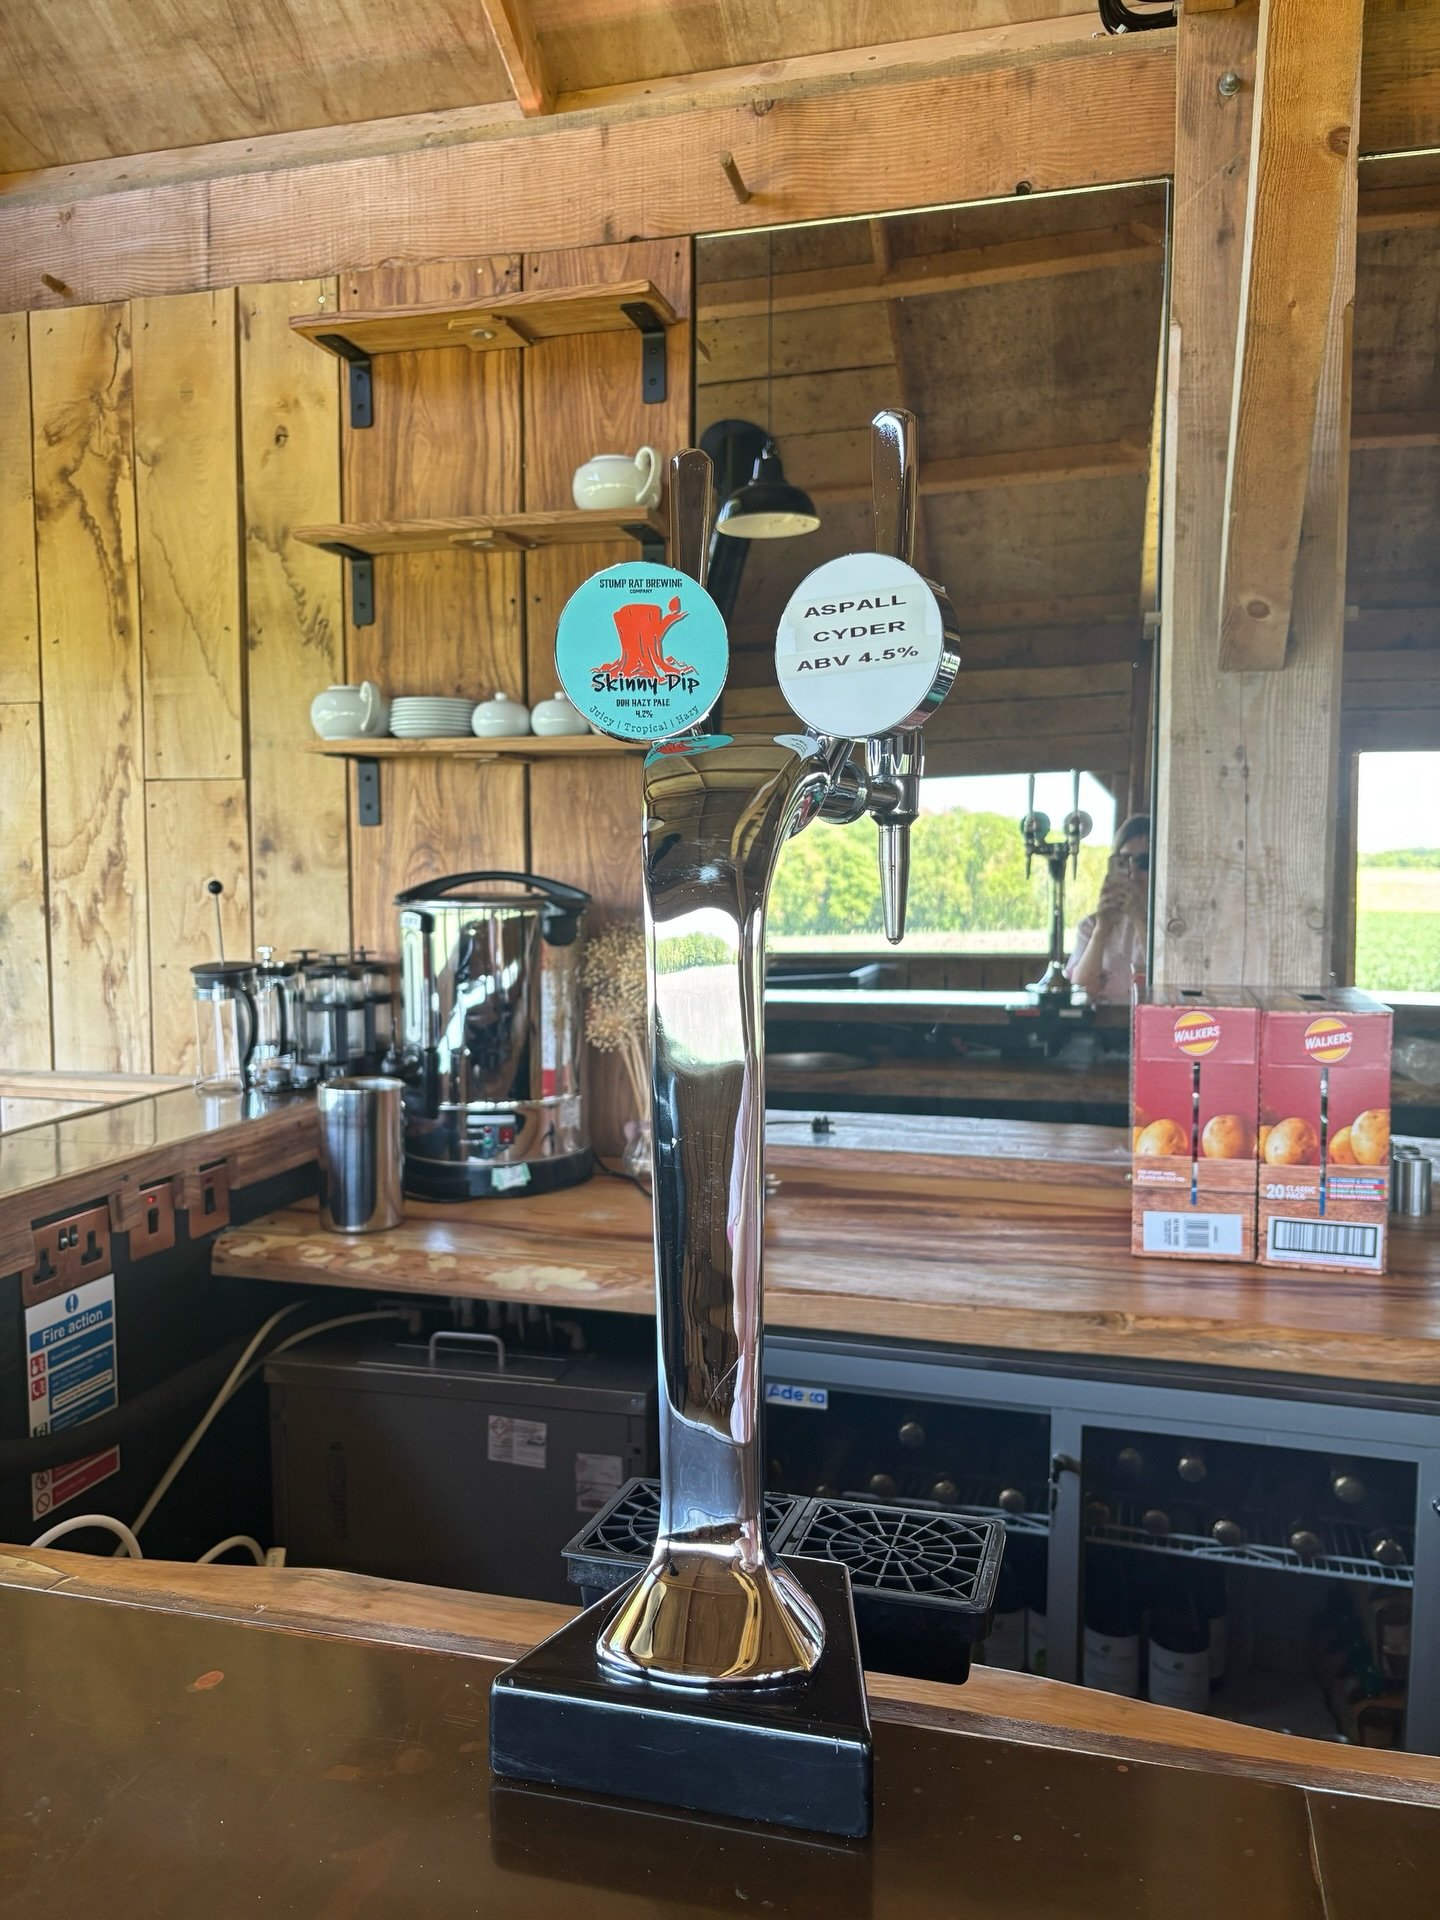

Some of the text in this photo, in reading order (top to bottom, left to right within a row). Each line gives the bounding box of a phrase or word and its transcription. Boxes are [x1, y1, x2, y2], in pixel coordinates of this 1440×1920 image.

[599, 578, 683, 589] STUMP RAT BREWING
[803, 594, 907, 619] ASPALL
[812, 620, 906, 643] CYDER
[796, 645, 920, 673] ABV 4.5%
[592, 672, 700, 696] Skinny Dip
[631, 698, 651, 707] HAZY
[653, 698, 671, 707] PALE
[589, 705, 700, 735] Juicy Tropical Hazy
[635, 709, 654, 718] 4.2%
[1173, 1024, 1221, 1043] WALKERS
[1304, 1031, 1354, 1051] WALKERS
[1266, 1183, 1285, 1199] 20
[41, 1309, 104, 1345] Fire action
